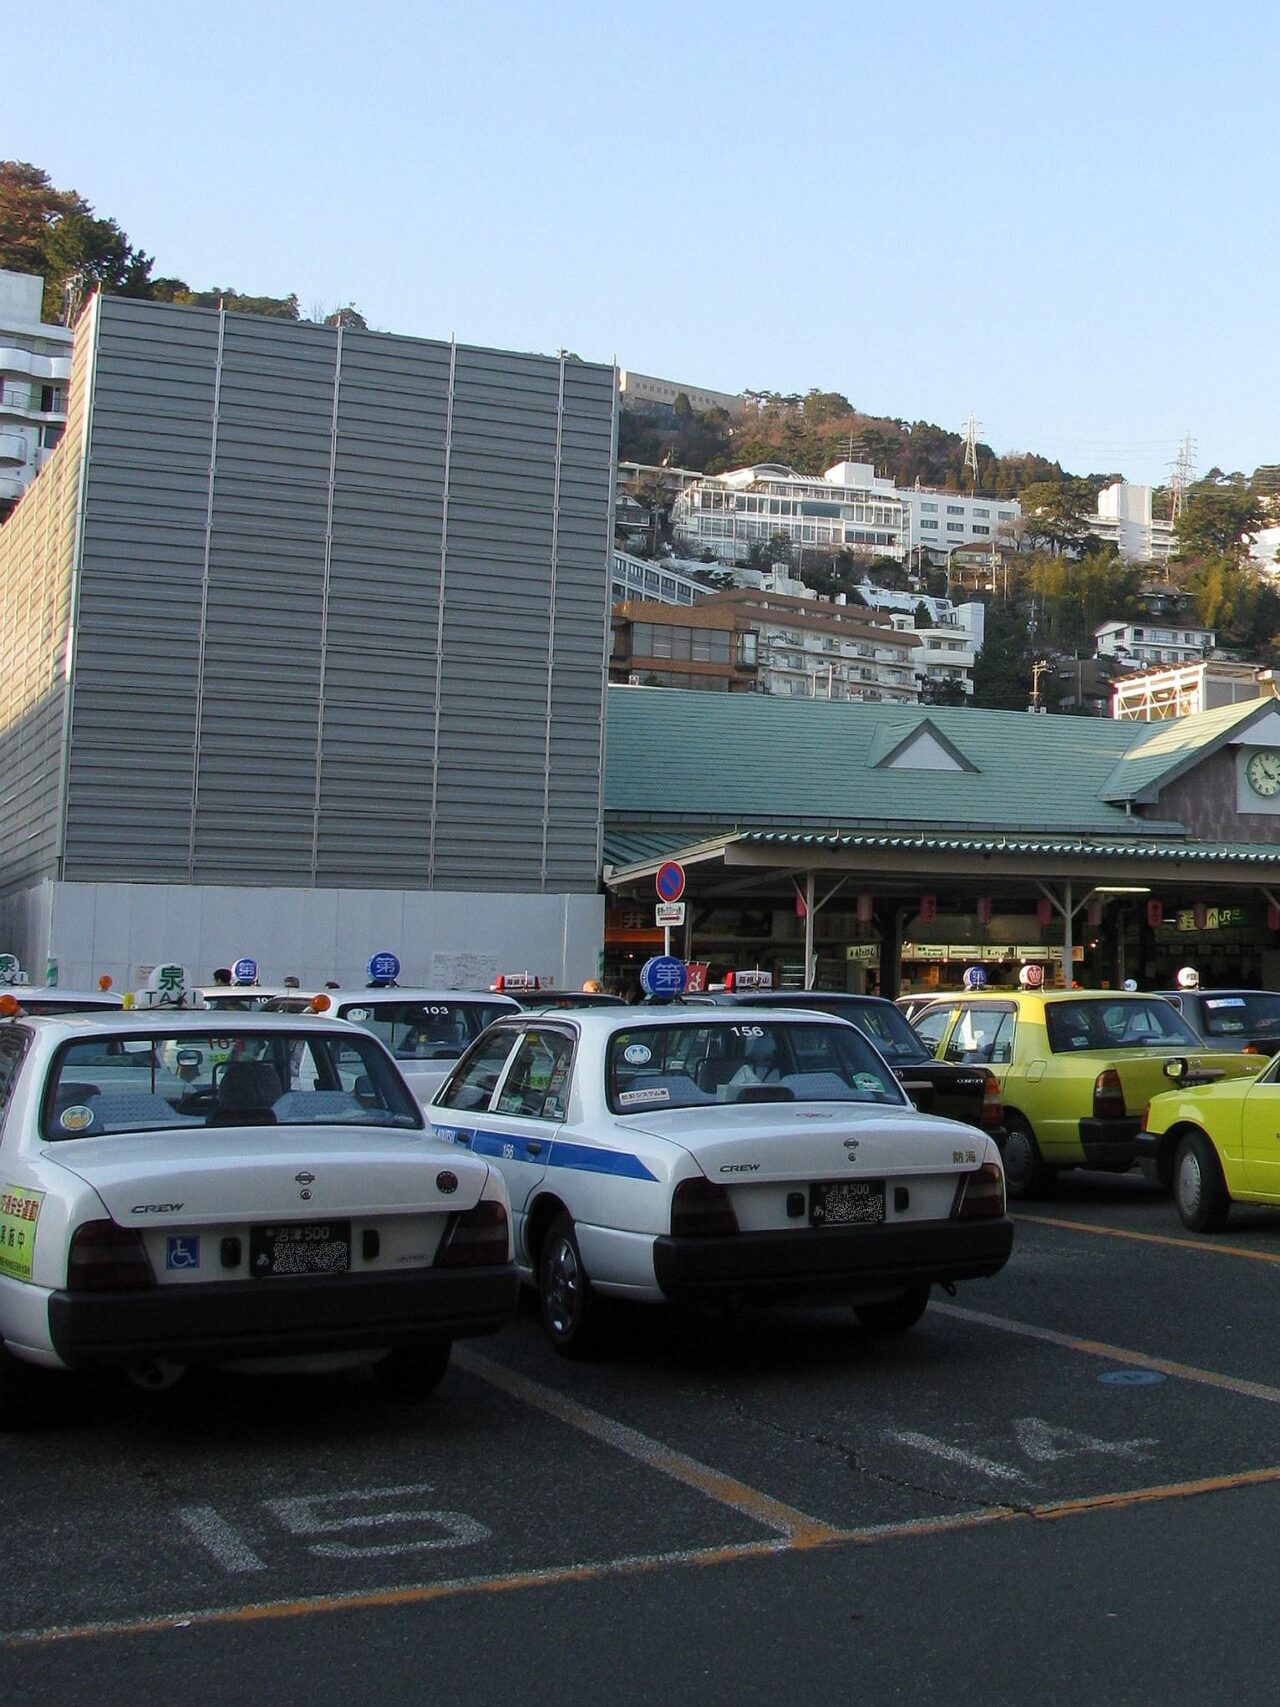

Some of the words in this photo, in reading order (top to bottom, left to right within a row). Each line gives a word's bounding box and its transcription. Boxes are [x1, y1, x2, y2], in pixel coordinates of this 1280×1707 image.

[159, 965, 185, 991] 泉
[145, 991, 197, 1006] TAXI
[423, 1006, 449, 1015] 103
[731, 1026, 764, 1037] 156
[503, 1143, 515, 1159] 156
[719, 1164, 761, 1173] CREW
[130, 1203, 185, 1214] CREW
[178, 1484, 493, 1572] 15
